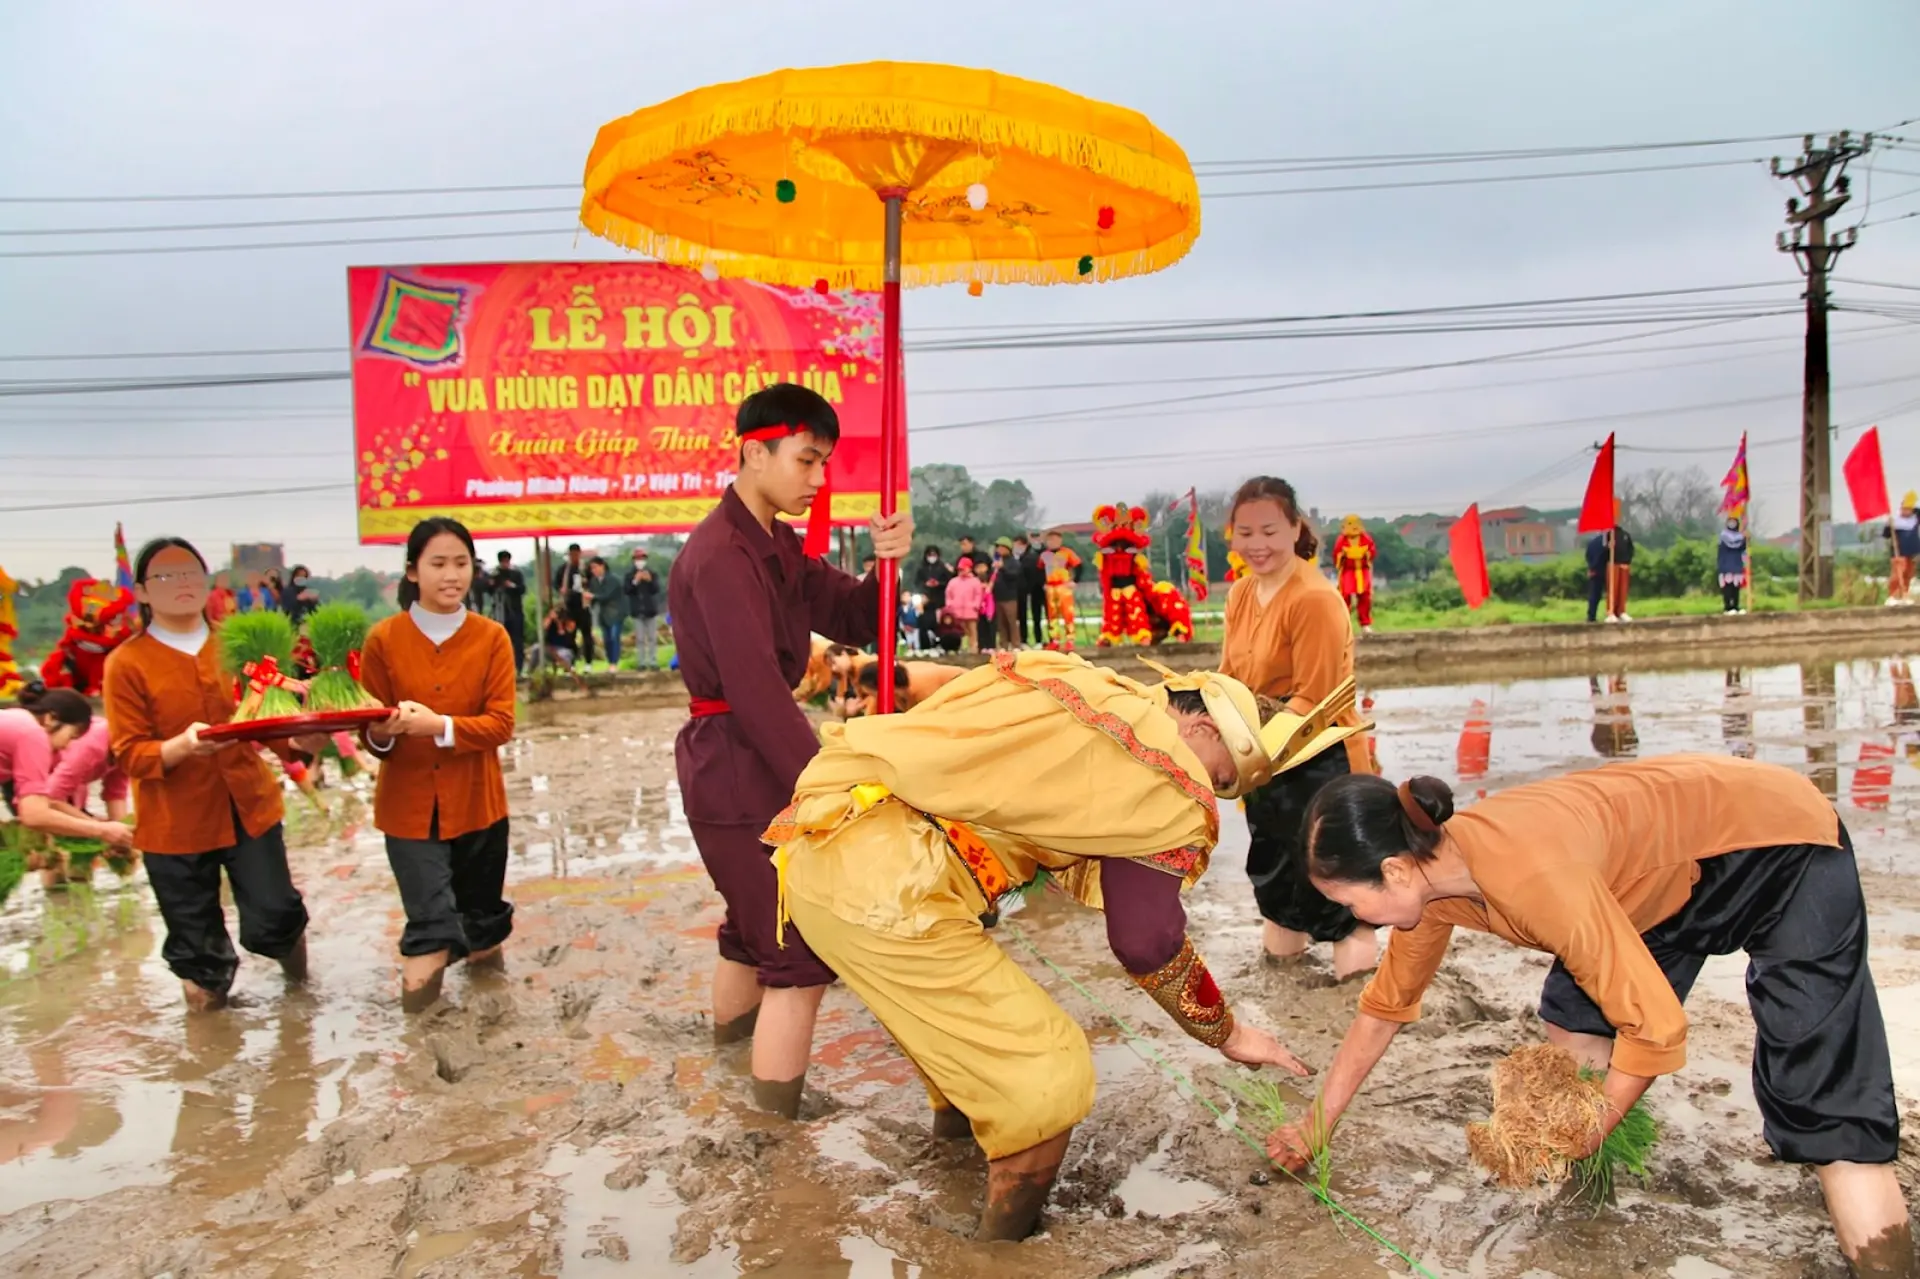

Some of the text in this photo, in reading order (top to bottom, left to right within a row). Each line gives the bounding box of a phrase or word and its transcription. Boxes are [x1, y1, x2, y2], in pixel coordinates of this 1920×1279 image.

[528, 284, 736, 358] LỄ HỘI
[495, 369, 579, 411] HÙNG
[587, 373, 645, 415] DẠY
[652, 366, 715, 407] DÂN
[488, 430, 566, 457] Xuân
[575, 427, 639, 459] Giáp
[648, 472, 679, 494] Việt
